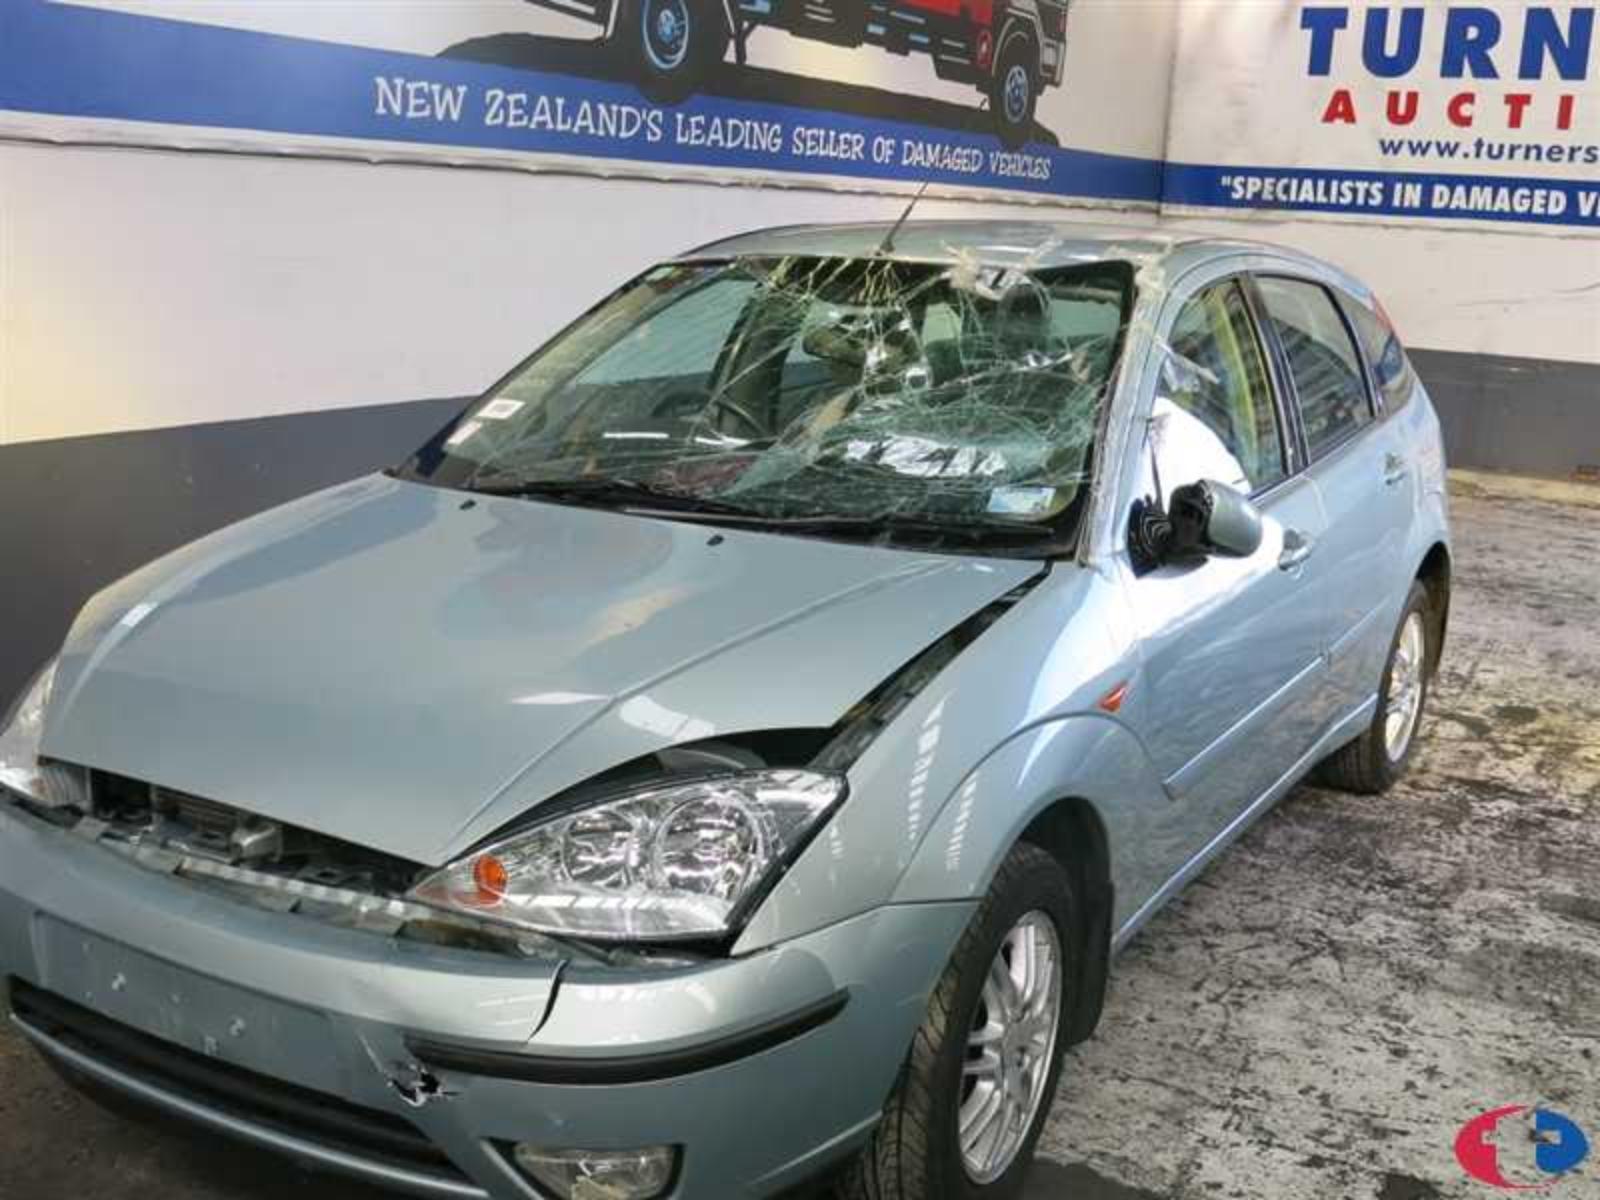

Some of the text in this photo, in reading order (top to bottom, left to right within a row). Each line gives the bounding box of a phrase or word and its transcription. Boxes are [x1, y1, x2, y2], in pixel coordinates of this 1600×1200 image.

[1300, 7, 1594, 80] TURN
[374, 76, 1052, 181] NEW ZEALAND'S LEADING SELLER OF DAMAGED VEHICLES
[1321, 89, 1574, 129] AUCTI
[1379, 137, 1598, 164] www.turners
[1220, 174, 1384, 207] "SPECIALISTS
[1392, 182, 1421, 209] IN
[1431, 183, 1567, 216] DAMAGED
